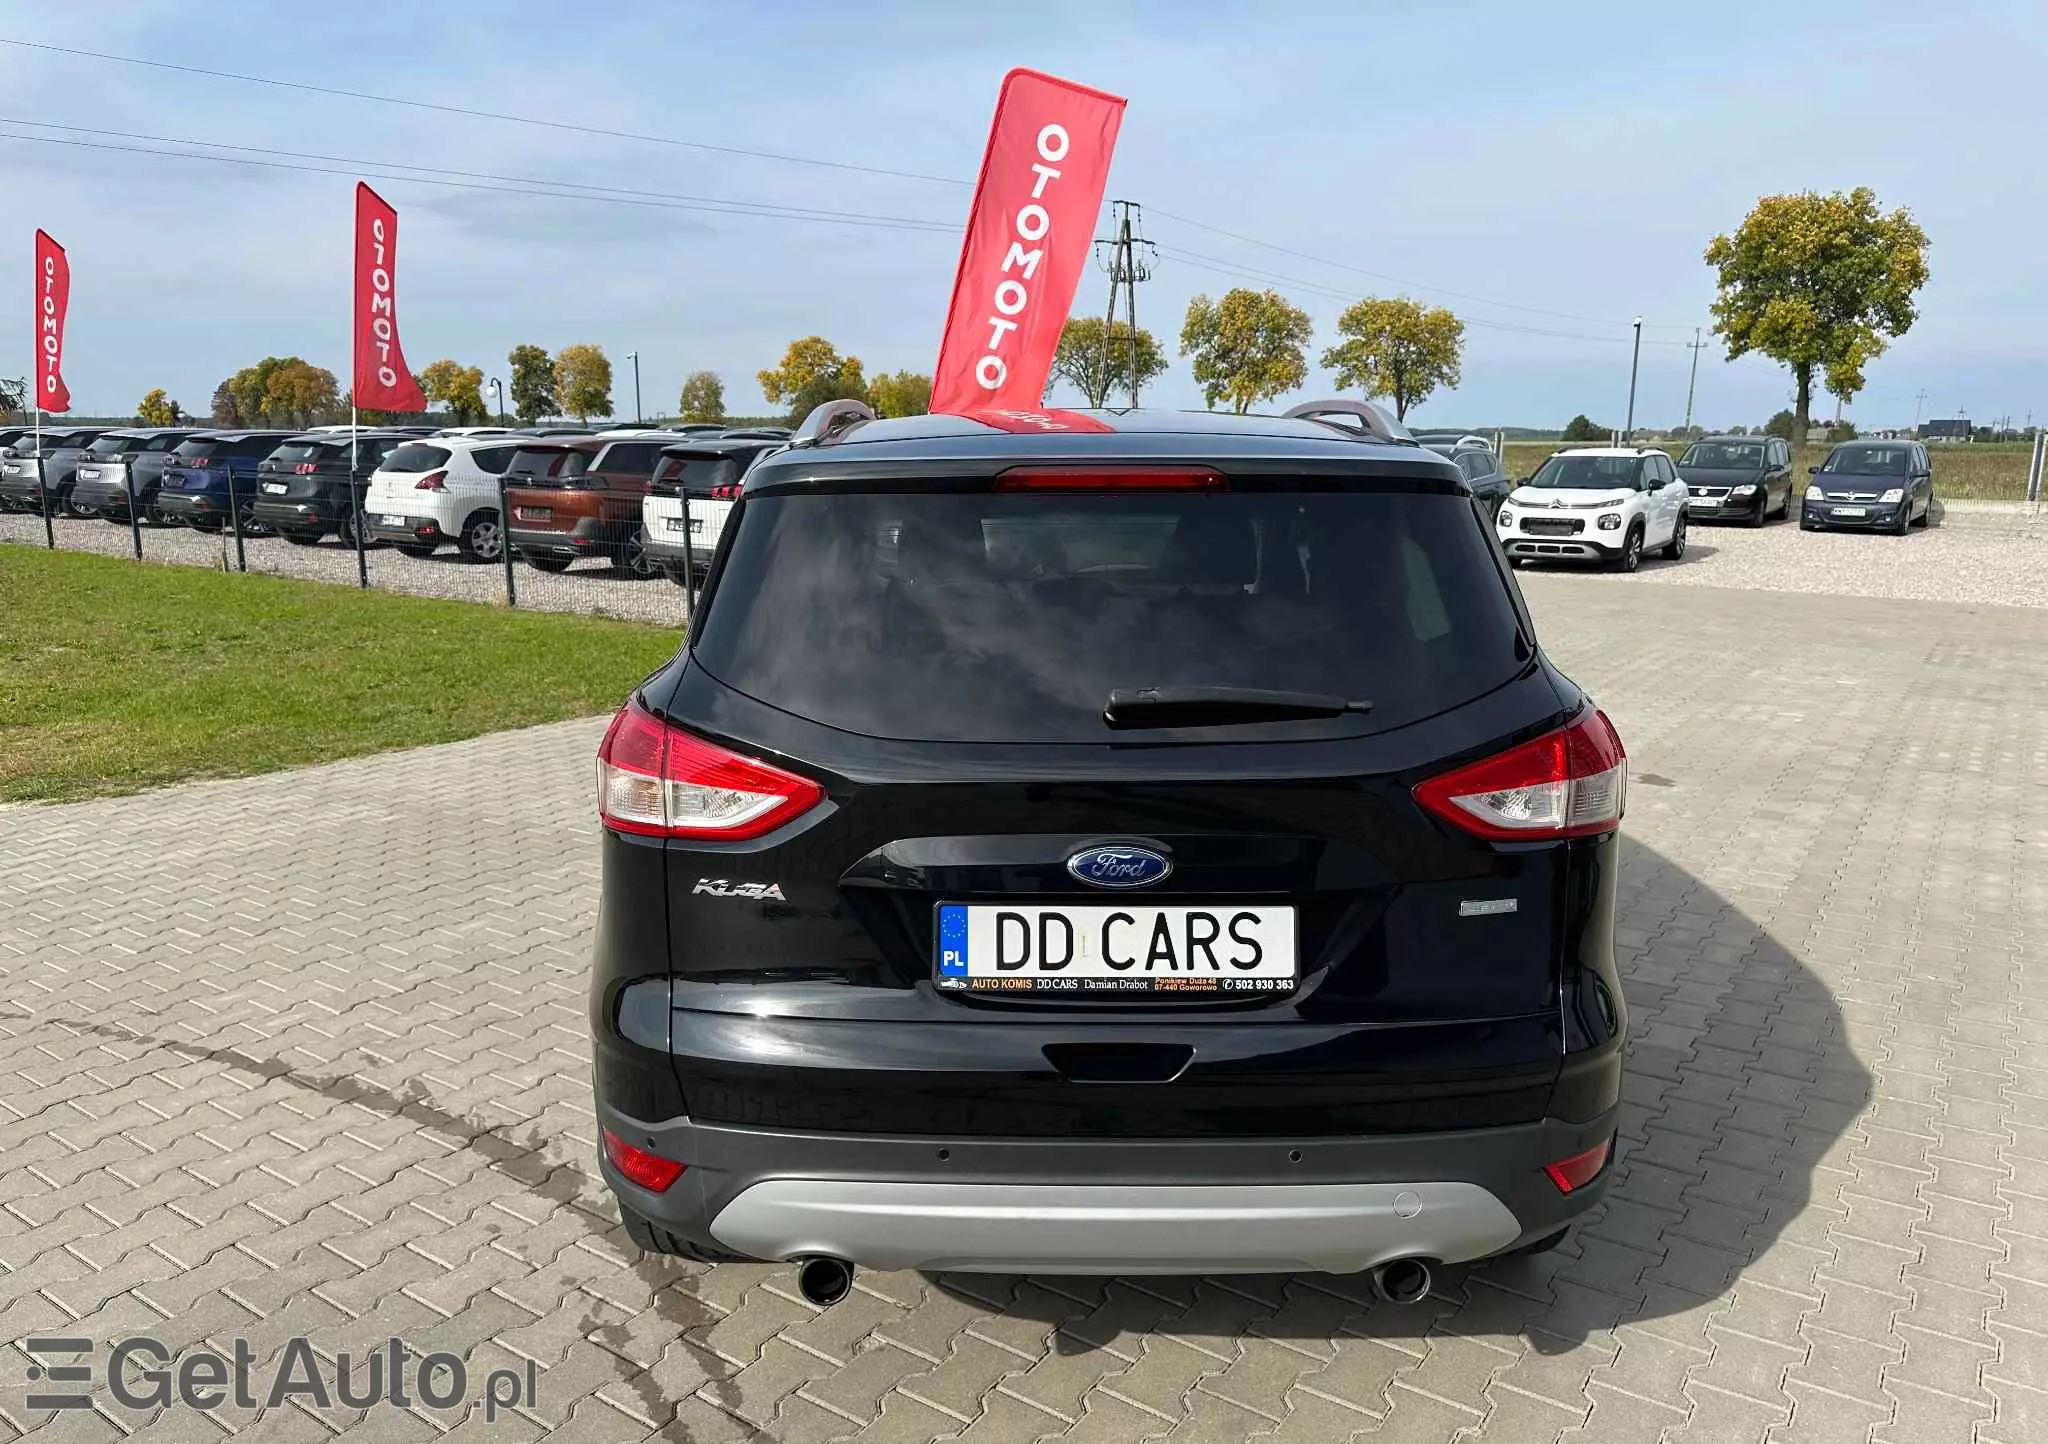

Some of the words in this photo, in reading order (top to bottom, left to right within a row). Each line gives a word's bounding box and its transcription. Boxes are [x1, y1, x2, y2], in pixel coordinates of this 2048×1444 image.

[975, 123, 1070, 390] OTOMOTO
[371, 218, 397, 388] OTOMOTO
[43, 256, 58, 393] OTOMOTO
[1091, 853, 1146, 877] Ford
[996, 911, 1074, 971] DD
[1101, 911, 1263, 971] CARS
[943, 951, 964, 967] PL
[972, 979, 999, 989] AUTO
[1001, 979, 1033, 989] KOMIS
[1037, 979, 1051, 989] DD
[1054, 979, 1079, 989] CARS
[1084, 979, 1118, 990] Damian
[1119, 979, 1149, 990] Drabot
[1235, 979, 1254, 990] 502
[1256, 979, 1274, 990] 930
[1276, 979, 1294, 990] 363
